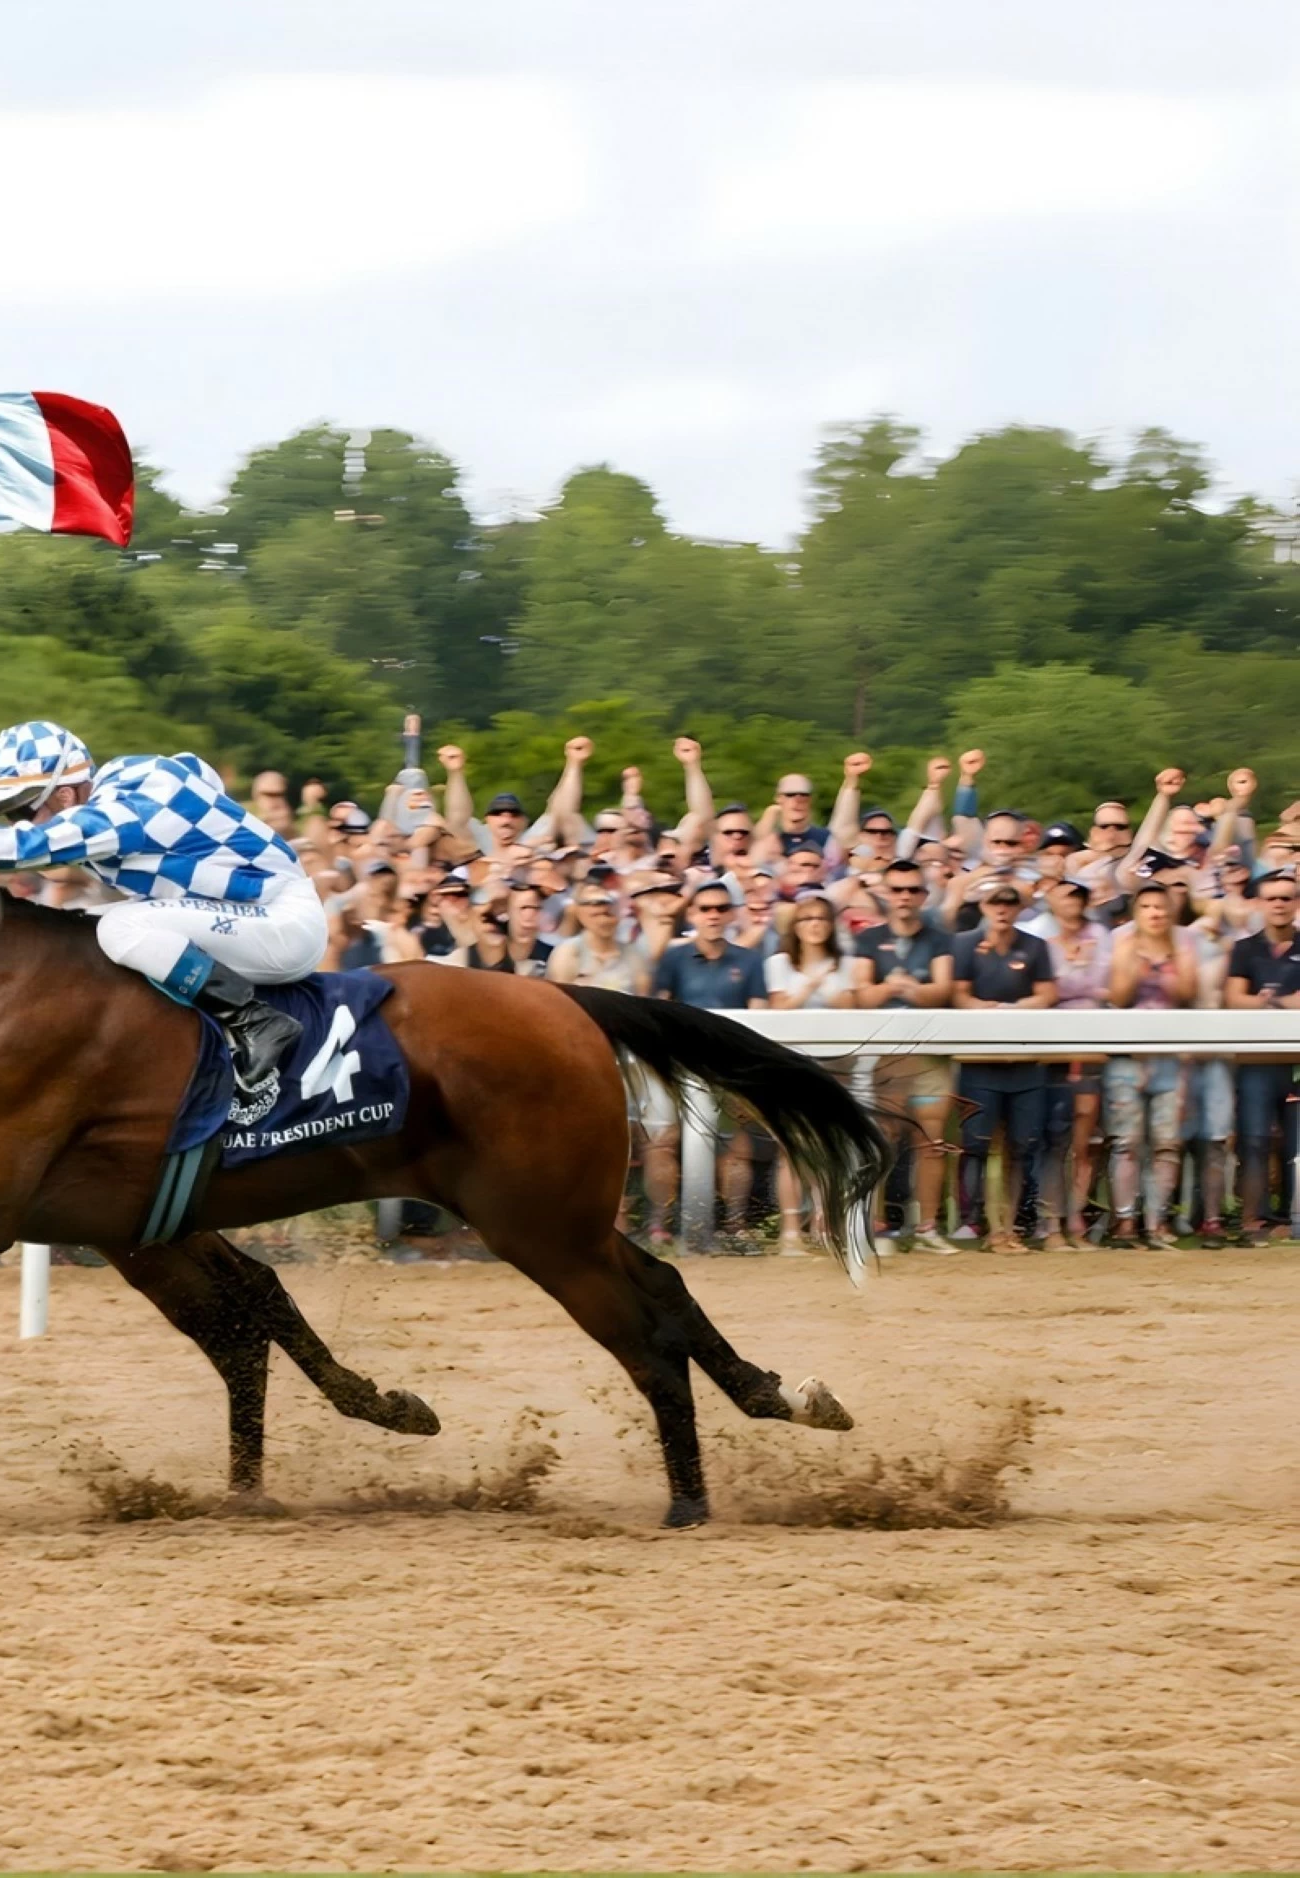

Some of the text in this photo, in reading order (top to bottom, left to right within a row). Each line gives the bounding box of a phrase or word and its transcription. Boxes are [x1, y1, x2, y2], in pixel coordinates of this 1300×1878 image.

[300, 1005, 361, 1104] 4
[223, 1102, 394, 1148] UAE PRESIDENT CUP
